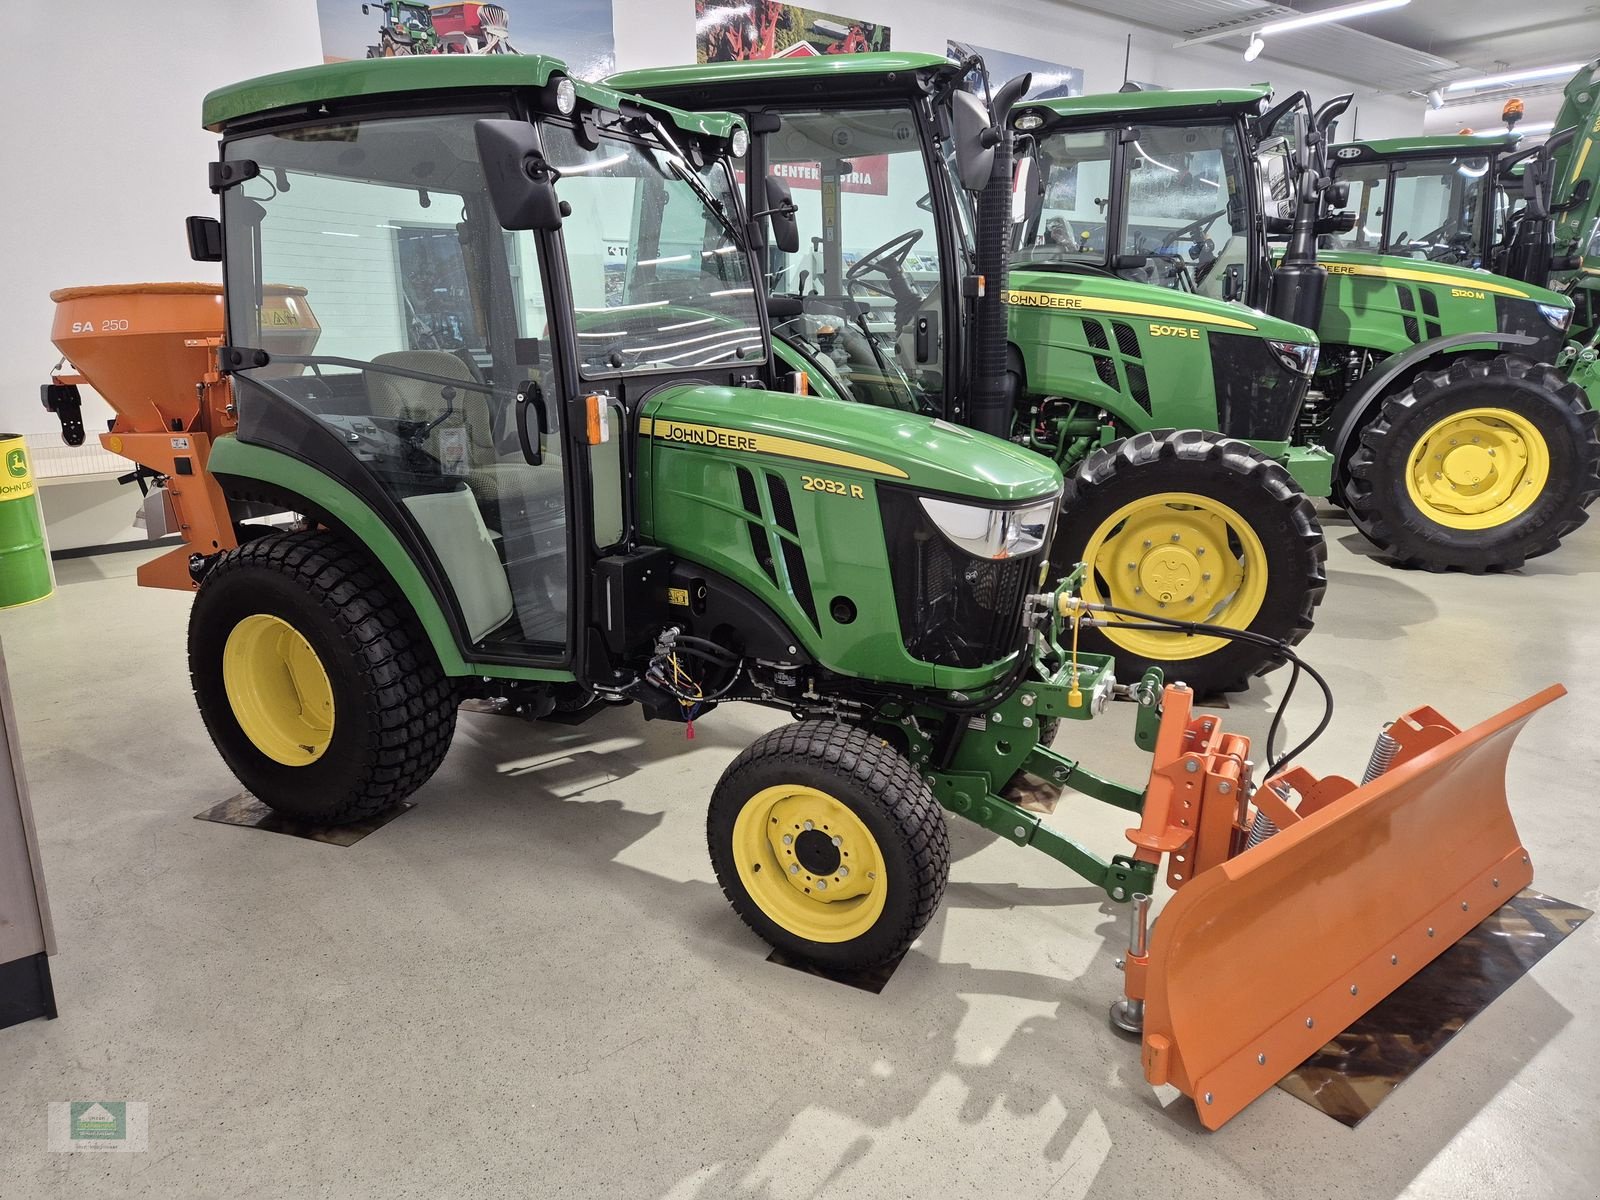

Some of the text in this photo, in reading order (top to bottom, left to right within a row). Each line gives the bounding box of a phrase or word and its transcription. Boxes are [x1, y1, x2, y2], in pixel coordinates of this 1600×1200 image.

[773, 163, 872, 185] CENTER TRIA
[1039, 295, 1083, 308] DEERE
[1451, 288, 1485, 300] 5120 M
[71, 319, 129, 333] SA 250
[1149, 323, 1201, 339] 5075 E
[665, 424, 757, 450] JOHN DEERE
[801, 475, 864, 500] 2032 R
